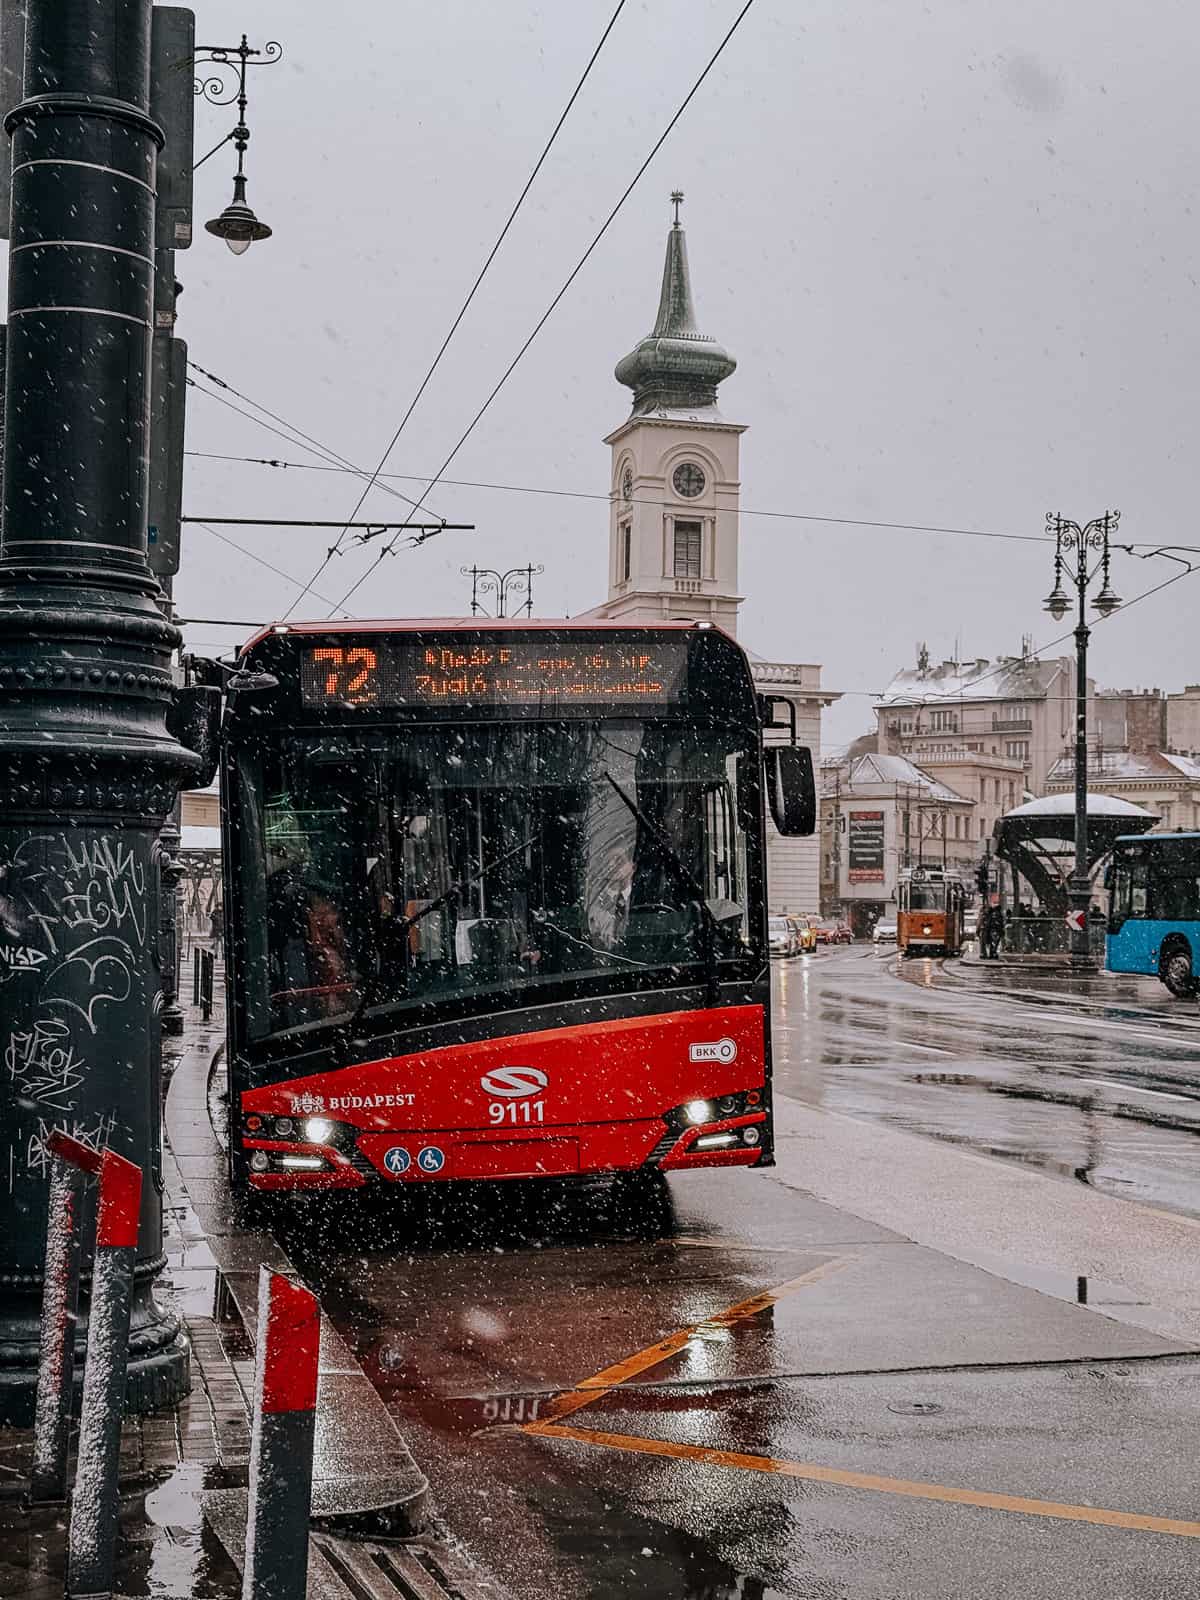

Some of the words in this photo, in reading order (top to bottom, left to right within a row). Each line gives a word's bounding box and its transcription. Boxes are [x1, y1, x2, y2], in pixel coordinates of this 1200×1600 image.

[314, 647, 377, 703] 72
[696, 1047, 717, 1056] BKK
[329, 1093, 416, 1109] BUDAPEST
[488, 1100, 545, 1124] 9111
